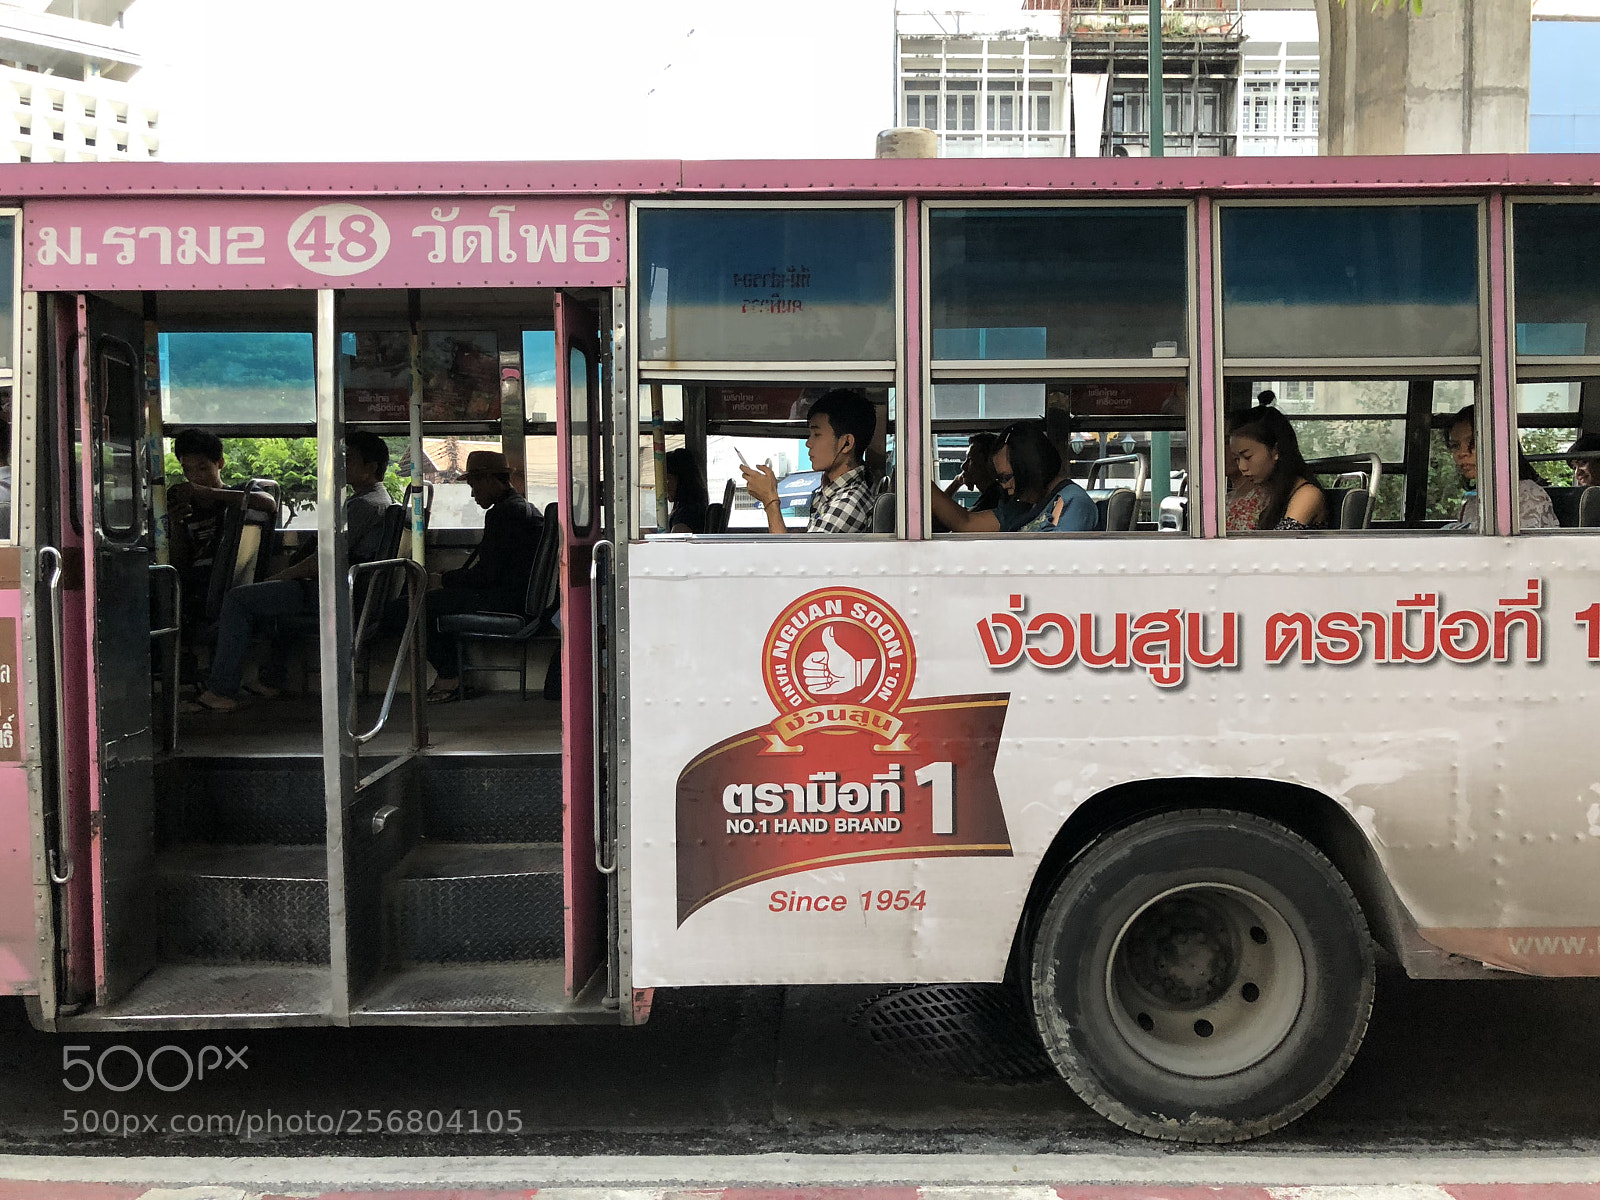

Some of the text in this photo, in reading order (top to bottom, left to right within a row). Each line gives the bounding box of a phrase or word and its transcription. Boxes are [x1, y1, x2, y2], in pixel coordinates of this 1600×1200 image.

[293, 214, 379, 263] 48
[412, 198, 616, 264] วัดโพธิ์
[773, 600, 903, 660] NGUAN SOON
[977, 580, 1600, 685] ง่วนสูน ตรามือที่ 1
[775, 664, 803, 707] HAND
[722, 762, 953, 834] ตรามือที่ 1
[727, 818, 900, 833] NO.1 HAND BRAND
[769, 891, 926, 912] Since 1954
[1508, 936, 1600, 956] www.
